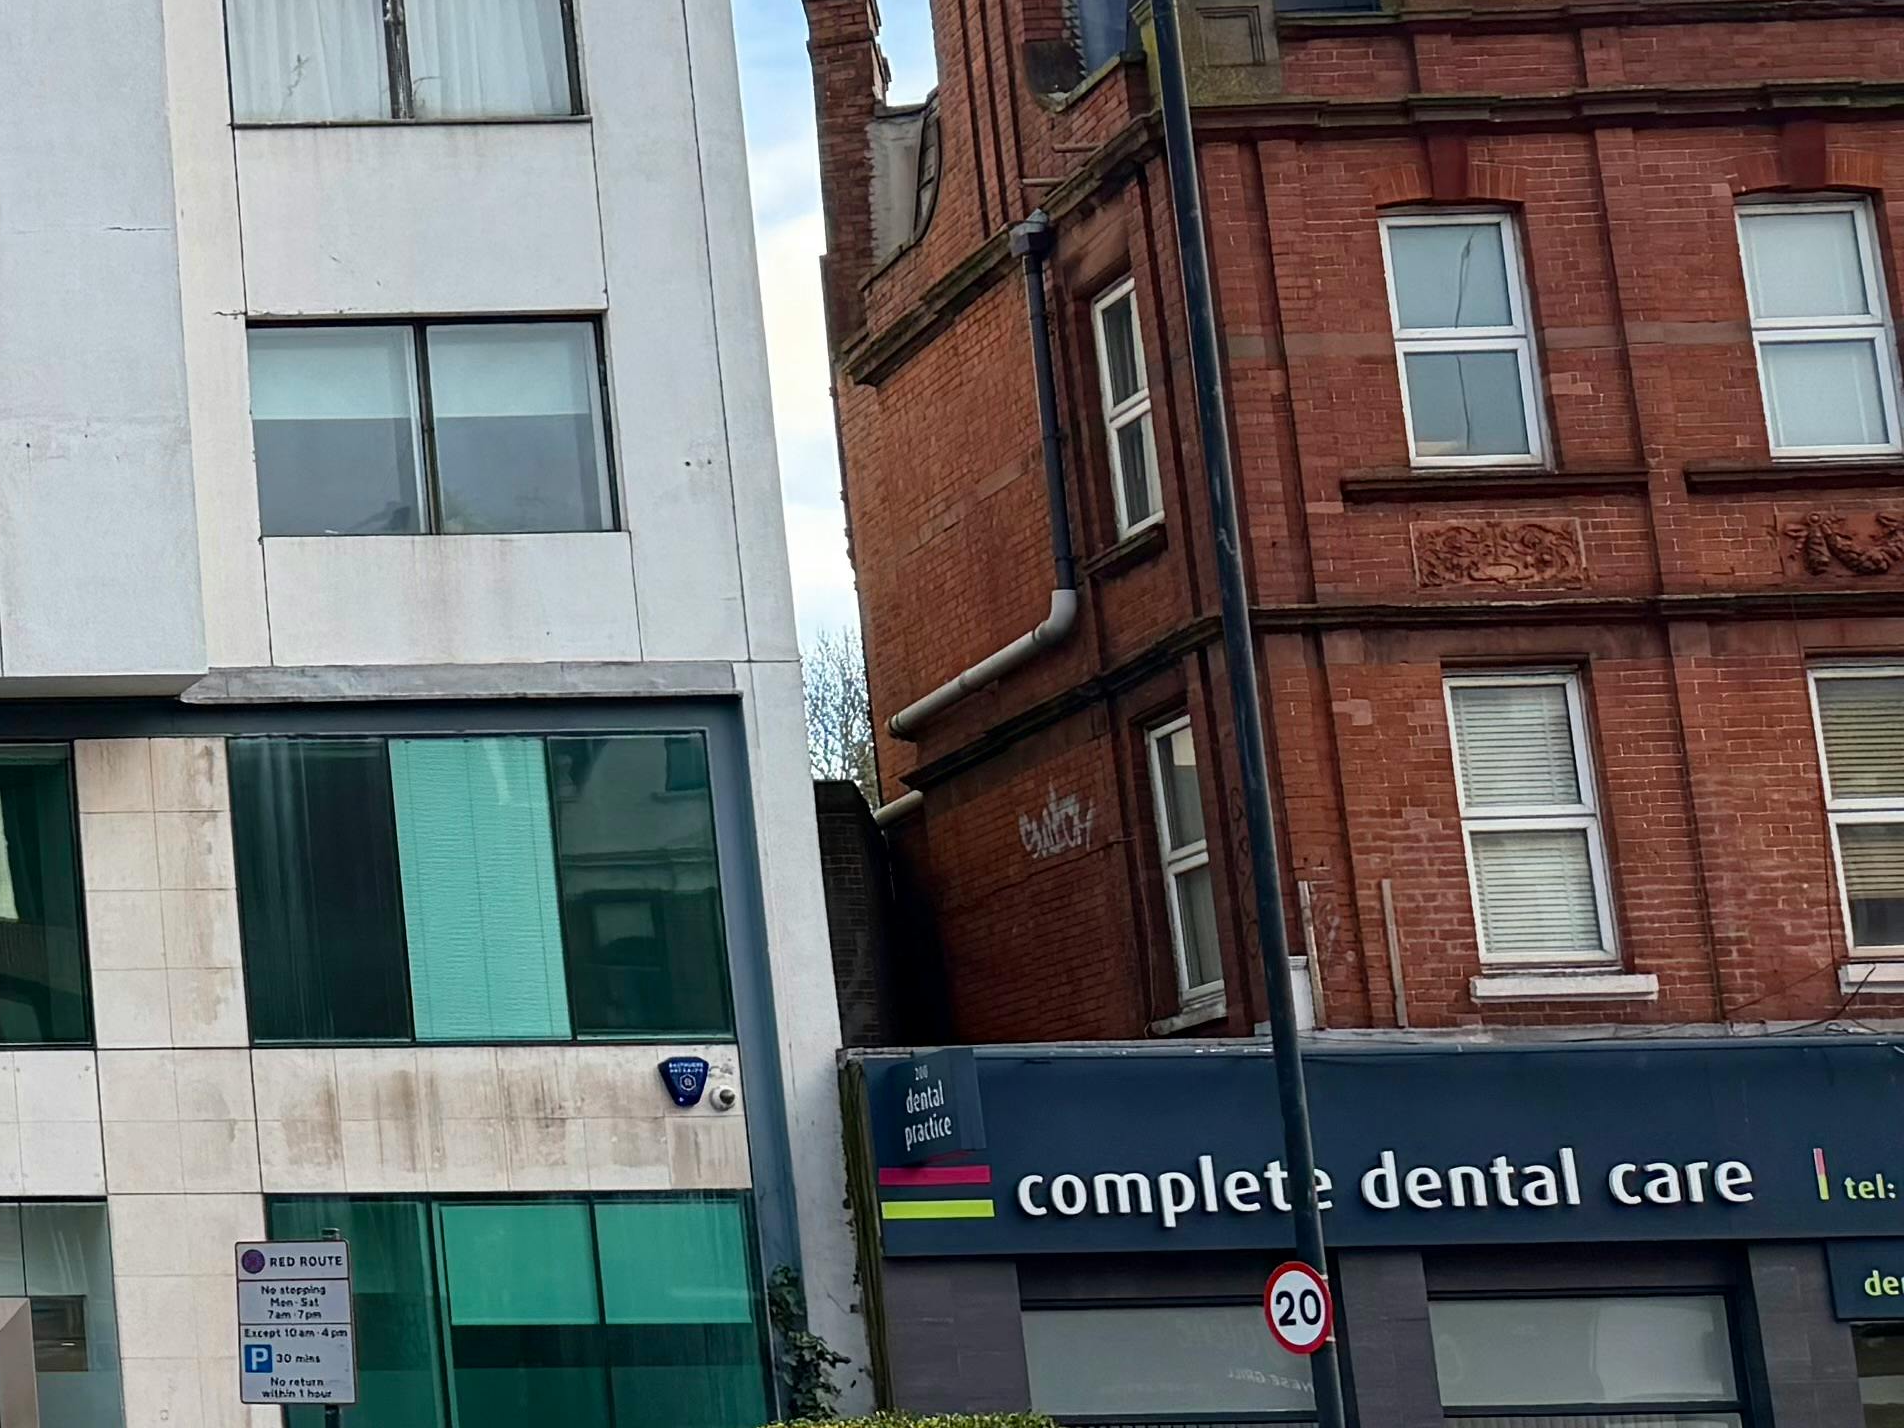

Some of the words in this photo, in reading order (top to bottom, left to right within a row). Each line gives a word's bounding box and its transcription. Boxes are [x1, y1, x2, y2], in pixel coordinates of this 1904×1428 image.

[905, 1079, 945, 1114] dental
[904, 1113, 953, 1152] practice
[1360, 1147, 1581, 1210] dental
[1608, 1158, 1754, 1206] care
[1843, 1174, 1897, 1201] tel:
[269, 1256, 296, 1268] RED
[299, 1255, 344, 1268] ROUTE
[260, 1285, 277, 1295] No
[279, 1285, 327, 1296] stopping
[1275, 1288, 1322, 1327] 20
[244, 1328, 282, 1339] Except
[275, 1353, 292, 1364] 30
[270, 1376, 287, 1387] No
[288, 1377, 325, 1387] return
[260, 1388, 297, 1399] within
[306, 1388, 333, 1399] hour
